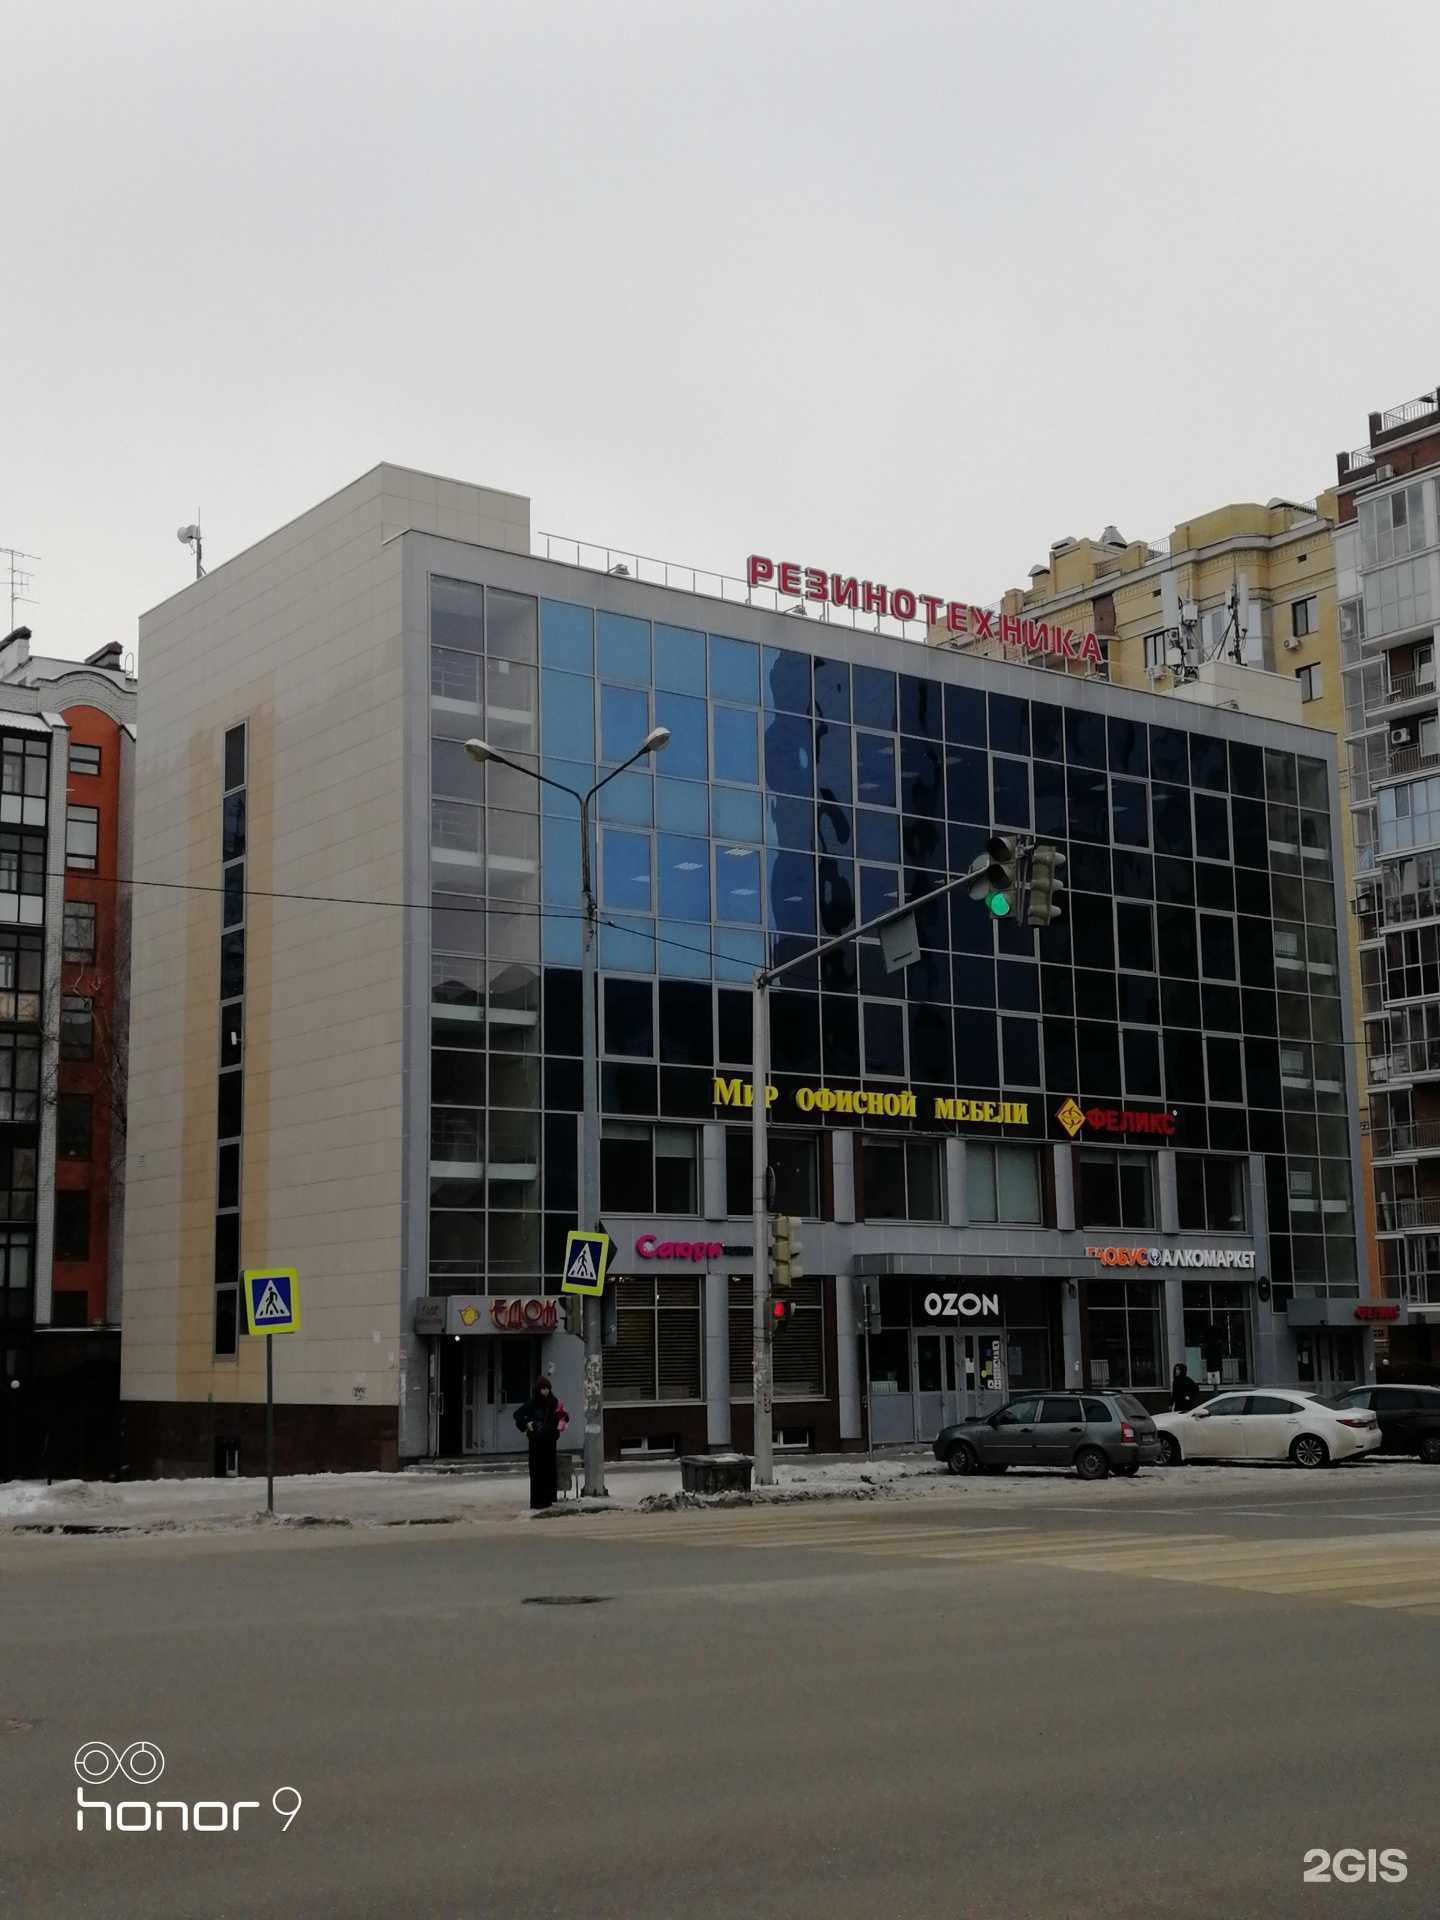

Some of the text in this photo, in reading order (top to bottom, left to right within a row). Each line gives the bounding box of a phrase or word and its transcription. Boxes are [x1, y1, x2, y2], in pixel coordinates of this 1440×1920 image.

[748, 554, 1102, 662] РЕЗИНОТЕХНИКА
[795, 1087, 918, 1118] ОФИСНОЙ
[934, 1097, 1030, 1125] МЕБЕЛИ
[1086, 1105, 1176, 1135] ФЕЛИКС
[1160, 1248, 1256, 1269] АЛКОМАРКЕТ
[924, 1293, 999, 1316] OZON
